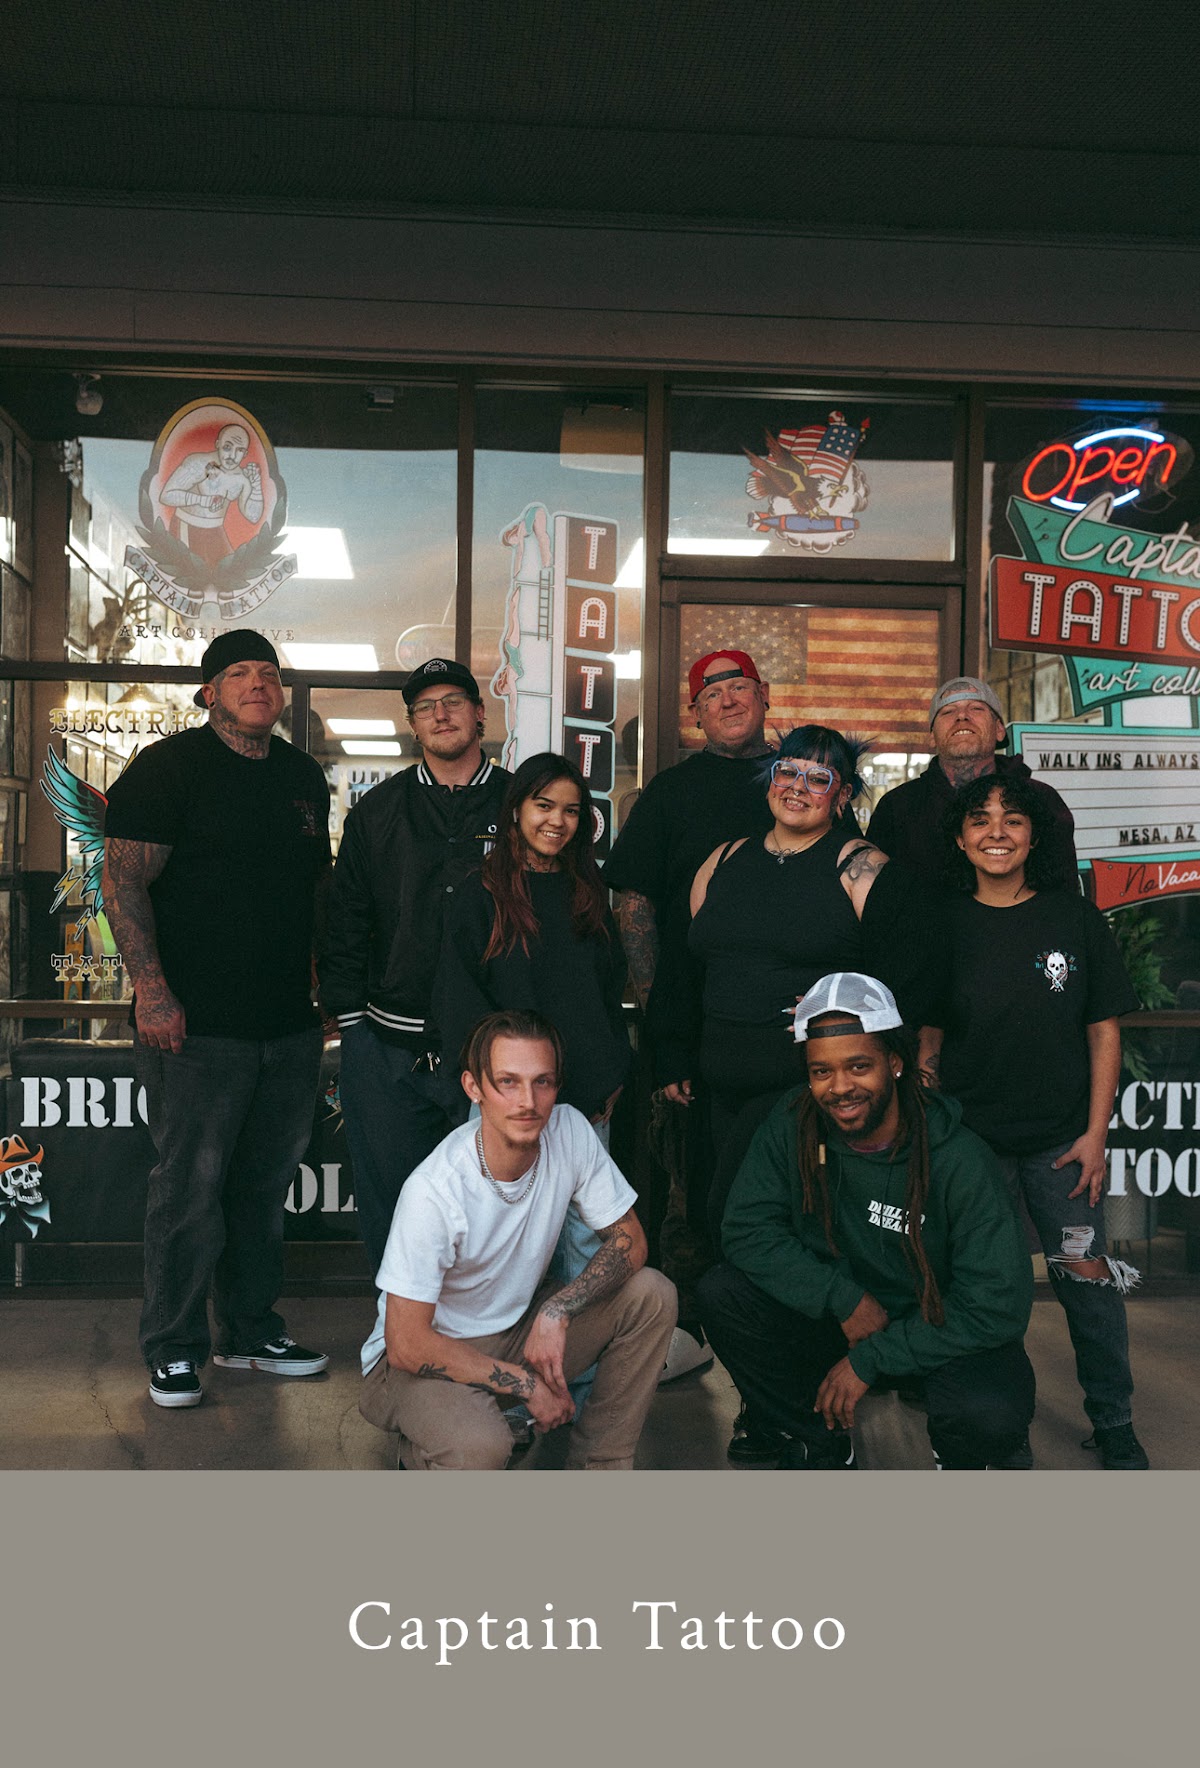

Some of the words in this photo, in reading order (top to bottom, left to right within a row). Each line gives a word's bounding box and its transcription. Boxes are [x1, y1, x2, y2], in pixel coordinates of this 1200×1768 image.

[1022, 442, 1177, 502] Open
[129, 552, 200, 617] CAPTAIN
[224, 559, 294, 618] TATTOO
[119, 625, 162, 639] ART
[1088, 662, 1142, 692] art
[50, 708, 201, 737] ELECTRIC
[1039, 752, 1089, 769] WALK
[1096, 753, 1122, 769] INS
[1133, 753, 1198, 769] ALWAYS
[1174, 824, 1195, 841] AZ
[51, 953, 131, 982] TAT
[1108, 1080, 1200, 1131] CT
[283, 1163, 358, 1213] OL
